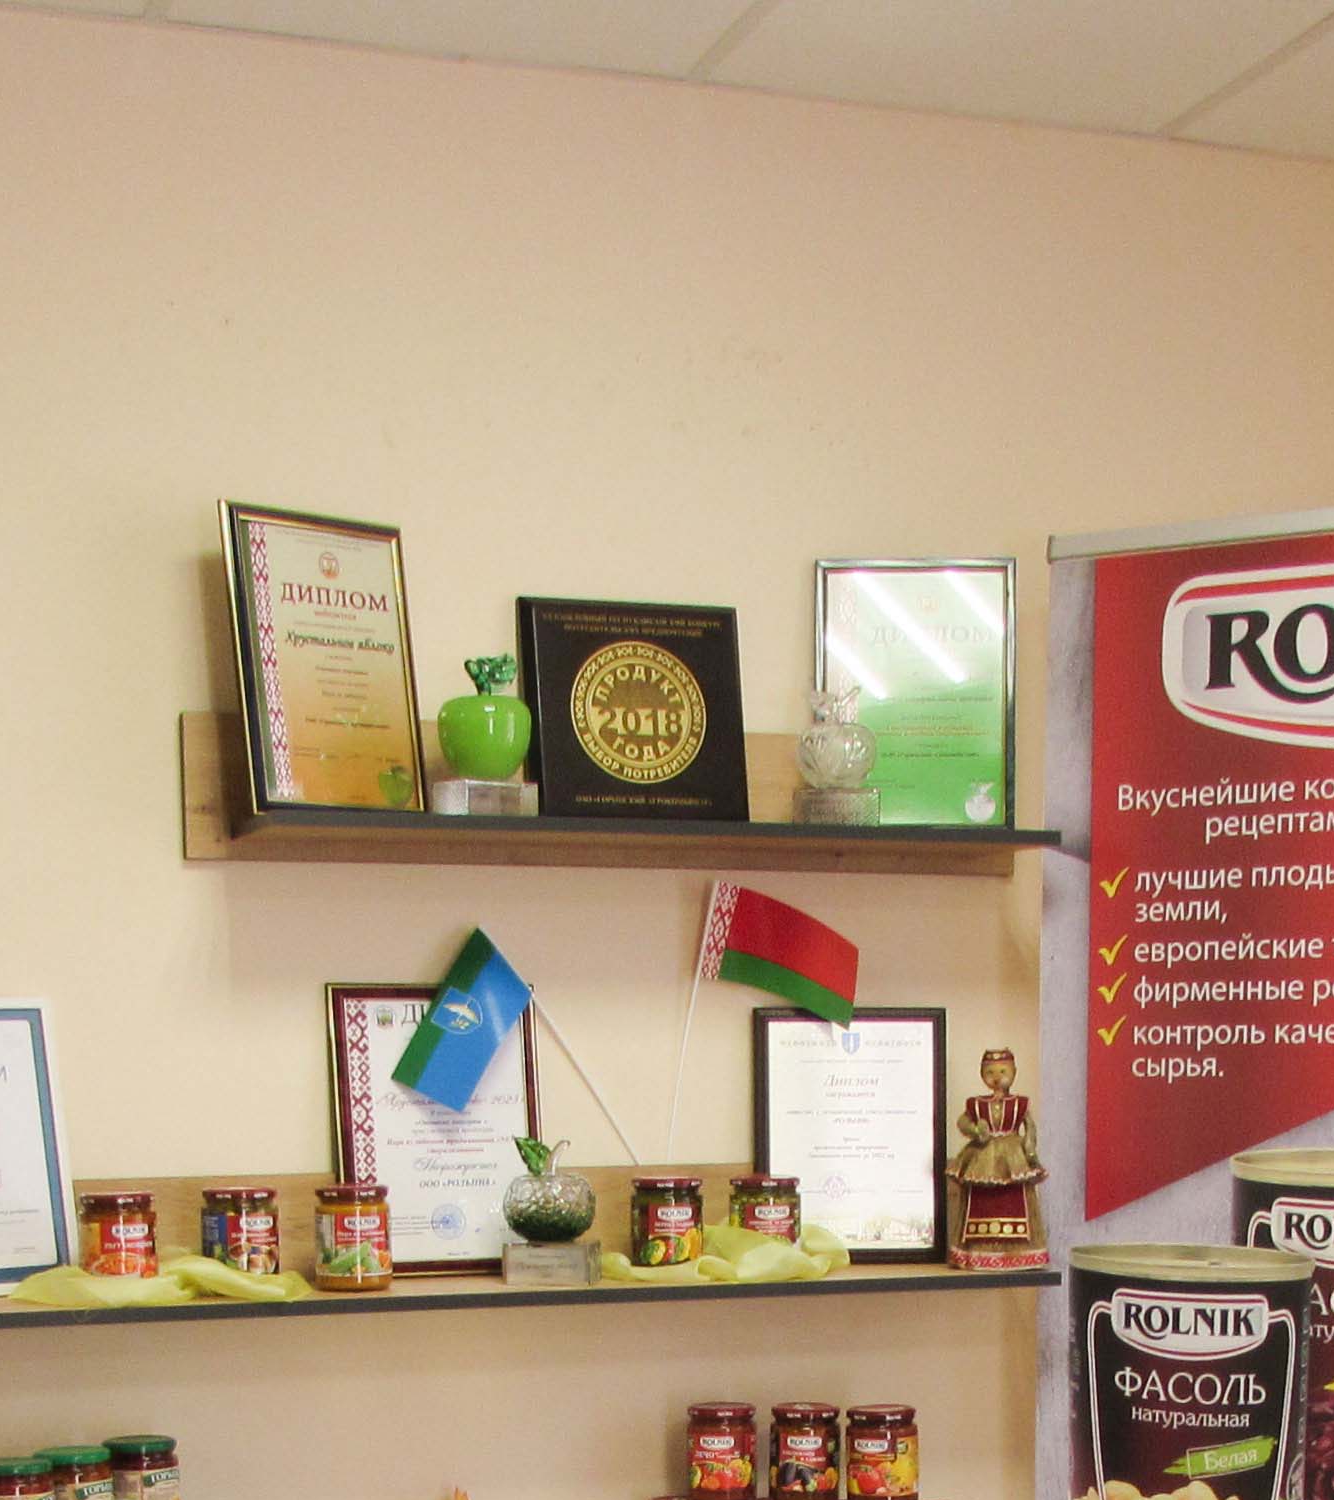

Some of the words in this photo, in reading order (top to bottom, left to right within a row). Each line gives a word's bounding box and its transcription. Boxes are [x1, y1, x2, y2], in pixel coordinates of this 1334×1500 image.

[281, 582, 389, 612] ДИПЛОМ
[595, 664, 684, 704] ПРОДУКТ
[597, 707, 684, 737] 2018
[582, 733, 621, 772] ВЫБОР
[623, 737, 699, 780] ПОТРЕБИТЕЛЯ
[612, 736, 671, 762] ГОДА
[1116, 779, 1296, 817] Вкуснейшие
[1133, 865, 1245, 901] лучшие
[1133, 898, 1229, 926] земли,
[1133, 933, 1324, 967] европейские
[1132, 973, 1307, 1010] фирменные
[1132, 1020, 1267, 1056] контроль
[1131, 1054, 1225, 1084] сырья.
[1122, 1302, 1257, 1341] ROLNIK
[1114, 1366, 1266, 1406] ФАСОЛЬ
[1131, 1405, 1250, 1429] натуральная
[1203, 1447, 1259, 1471] Белая
